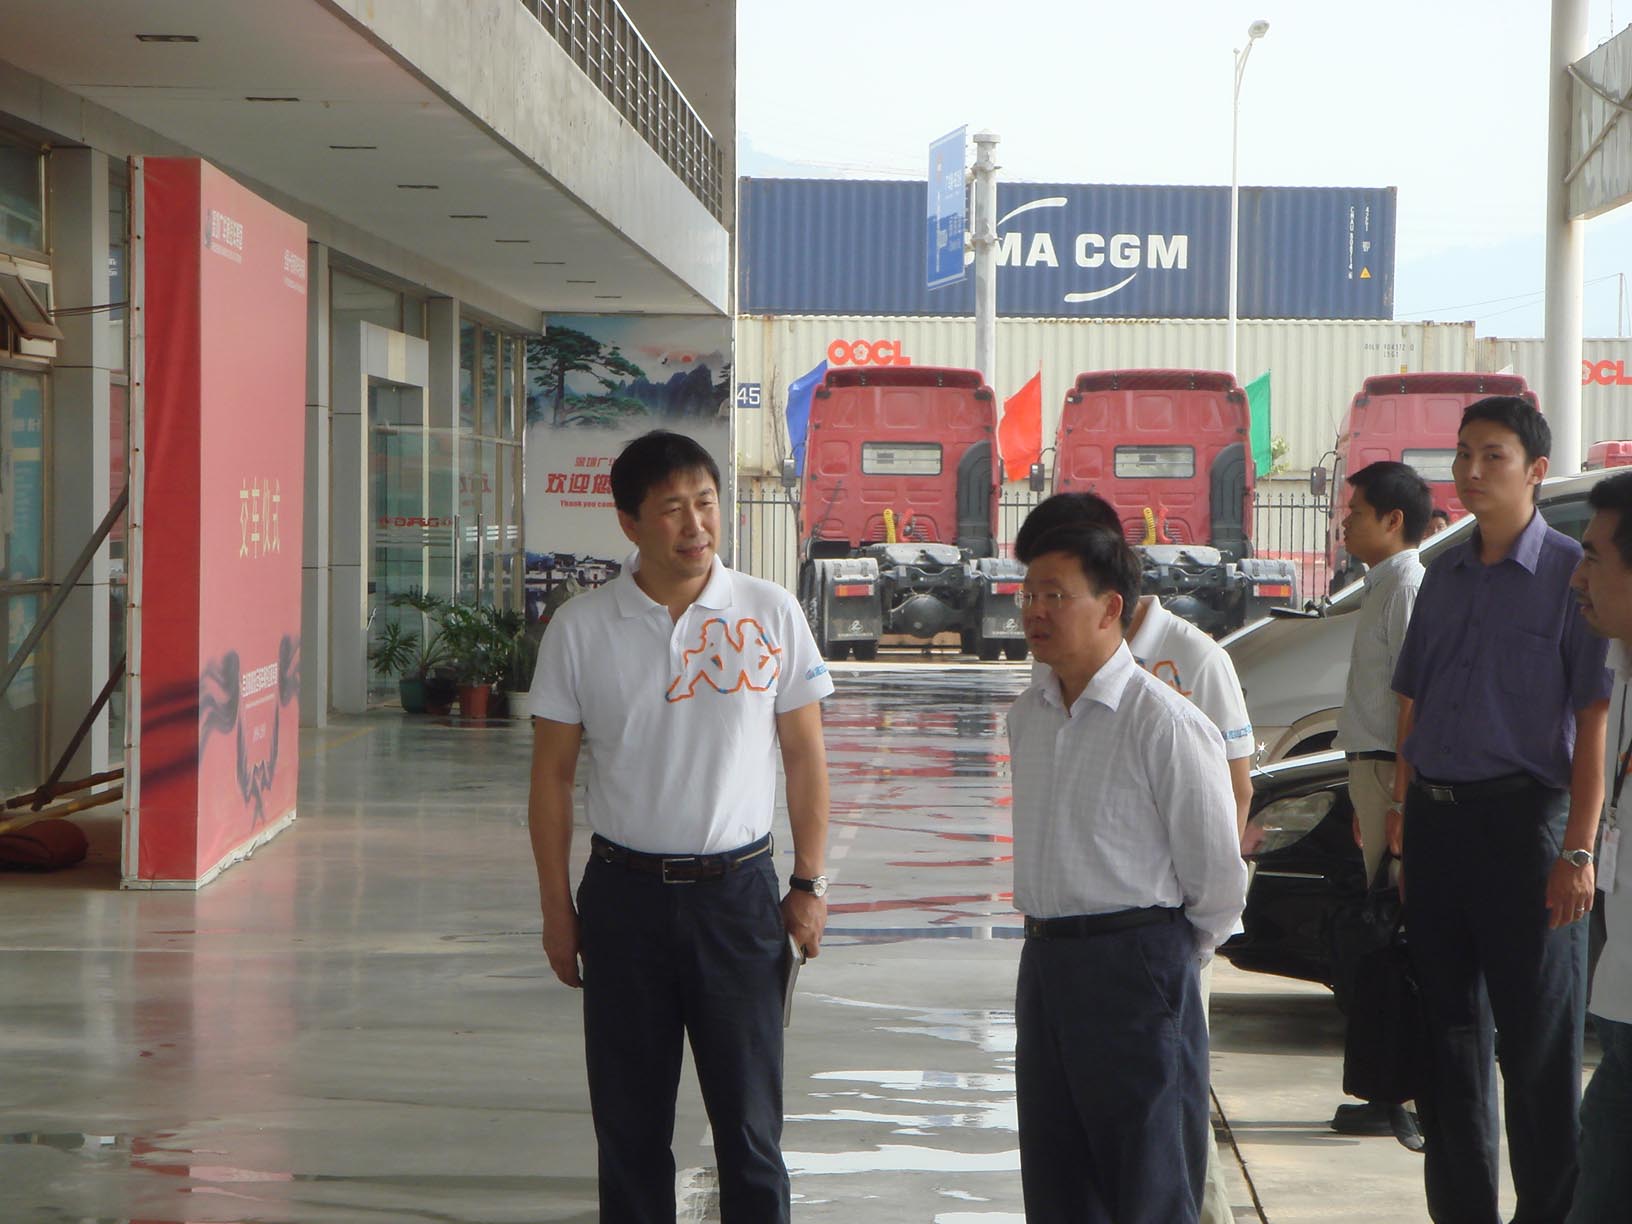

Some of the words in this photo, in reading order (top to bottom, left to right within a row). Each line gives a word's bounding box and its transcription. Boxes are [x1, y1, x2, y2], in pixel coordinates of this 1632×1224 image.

[1075, 234, 1188, 270] CGM
[828, 339, 911, 366] OOCL
[737, 387, 760, 405] 45
